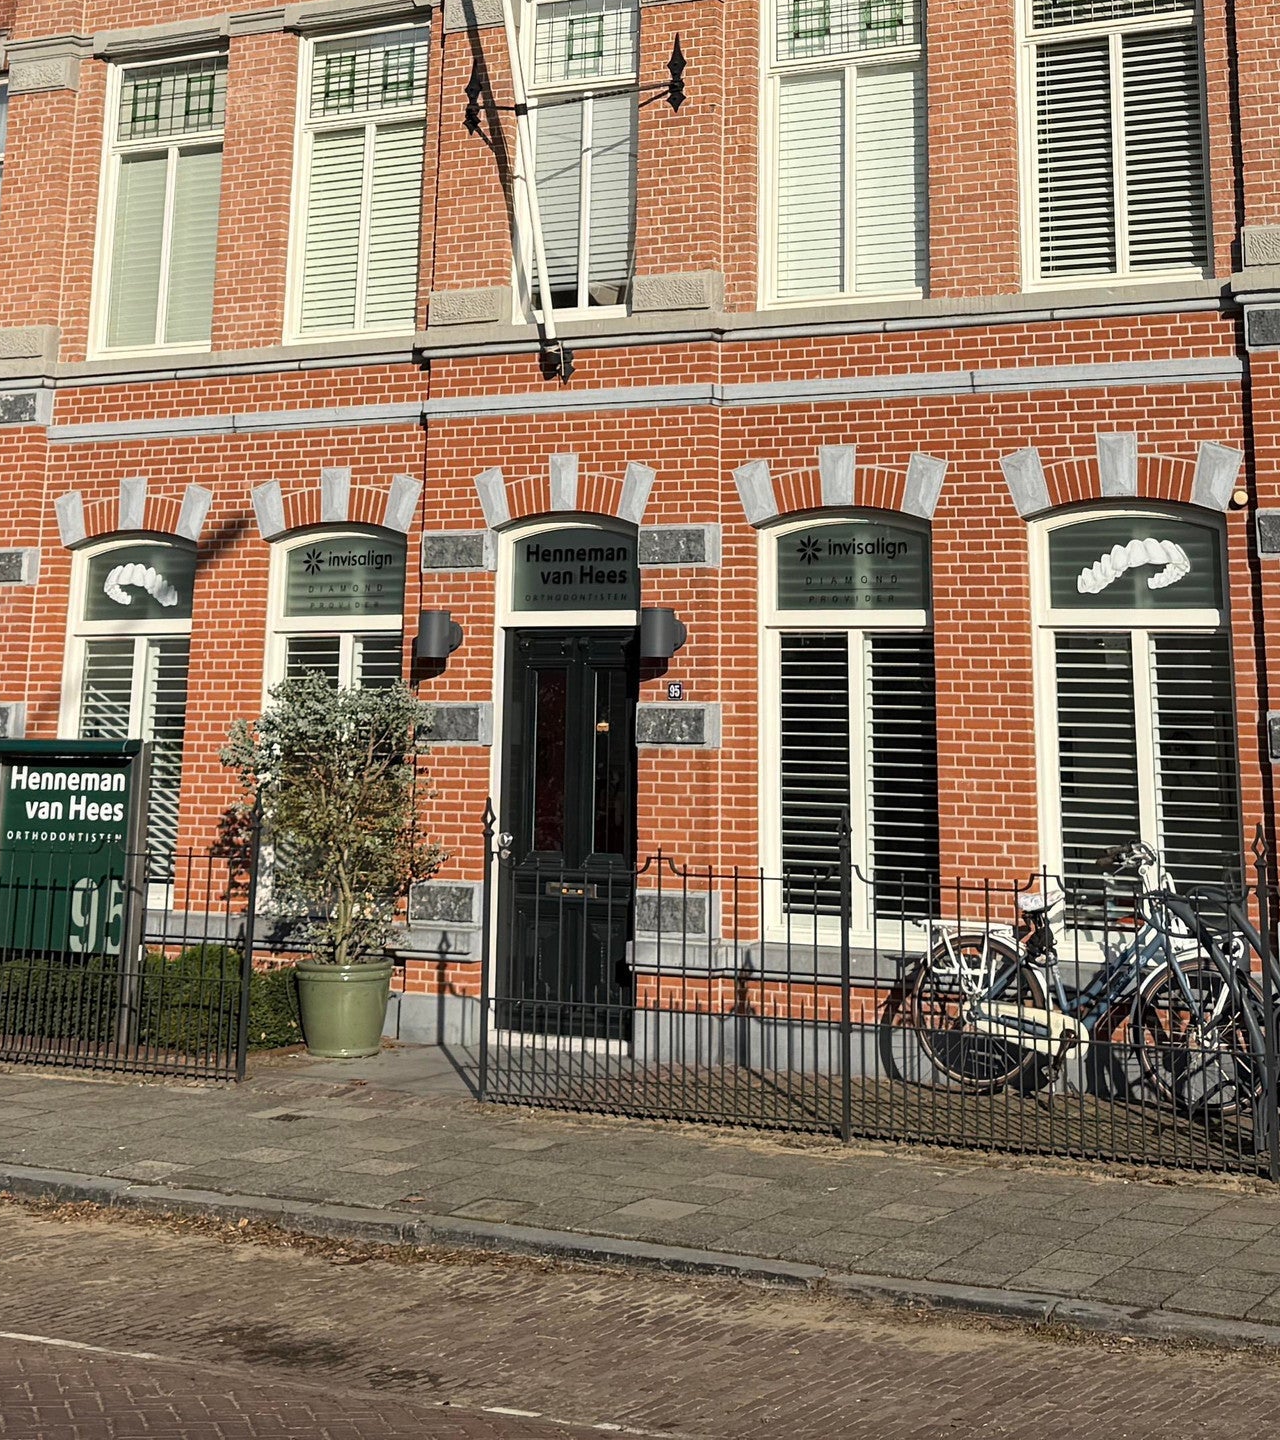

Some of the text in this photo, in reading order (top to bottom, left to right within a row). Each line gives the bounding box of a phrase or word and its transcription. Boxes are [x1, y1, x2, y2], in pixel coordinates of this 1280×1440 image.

[526, 544, 627, 563] Henneman
[828, 537, 908, 559] invisalign
[328, 549, 393, 570] invisalign
[540, 565, 627, 585] van Hees
[805, 575, 898, 585] DIAMOND
[308, 584, 383, 593] DIAMOND
[525, 592, 628, 602] ORTHODONTISTEN
[808, 595, 896, 604] PROVIDER
[669, 684, 680, 697] 95
[10, 765, 126, 792] Henneman
[25, 795, 124, 822] van Hees
[6, 830, 122, 843] ORTHODONTISTEN
[69, 877, 124, 955] 95
